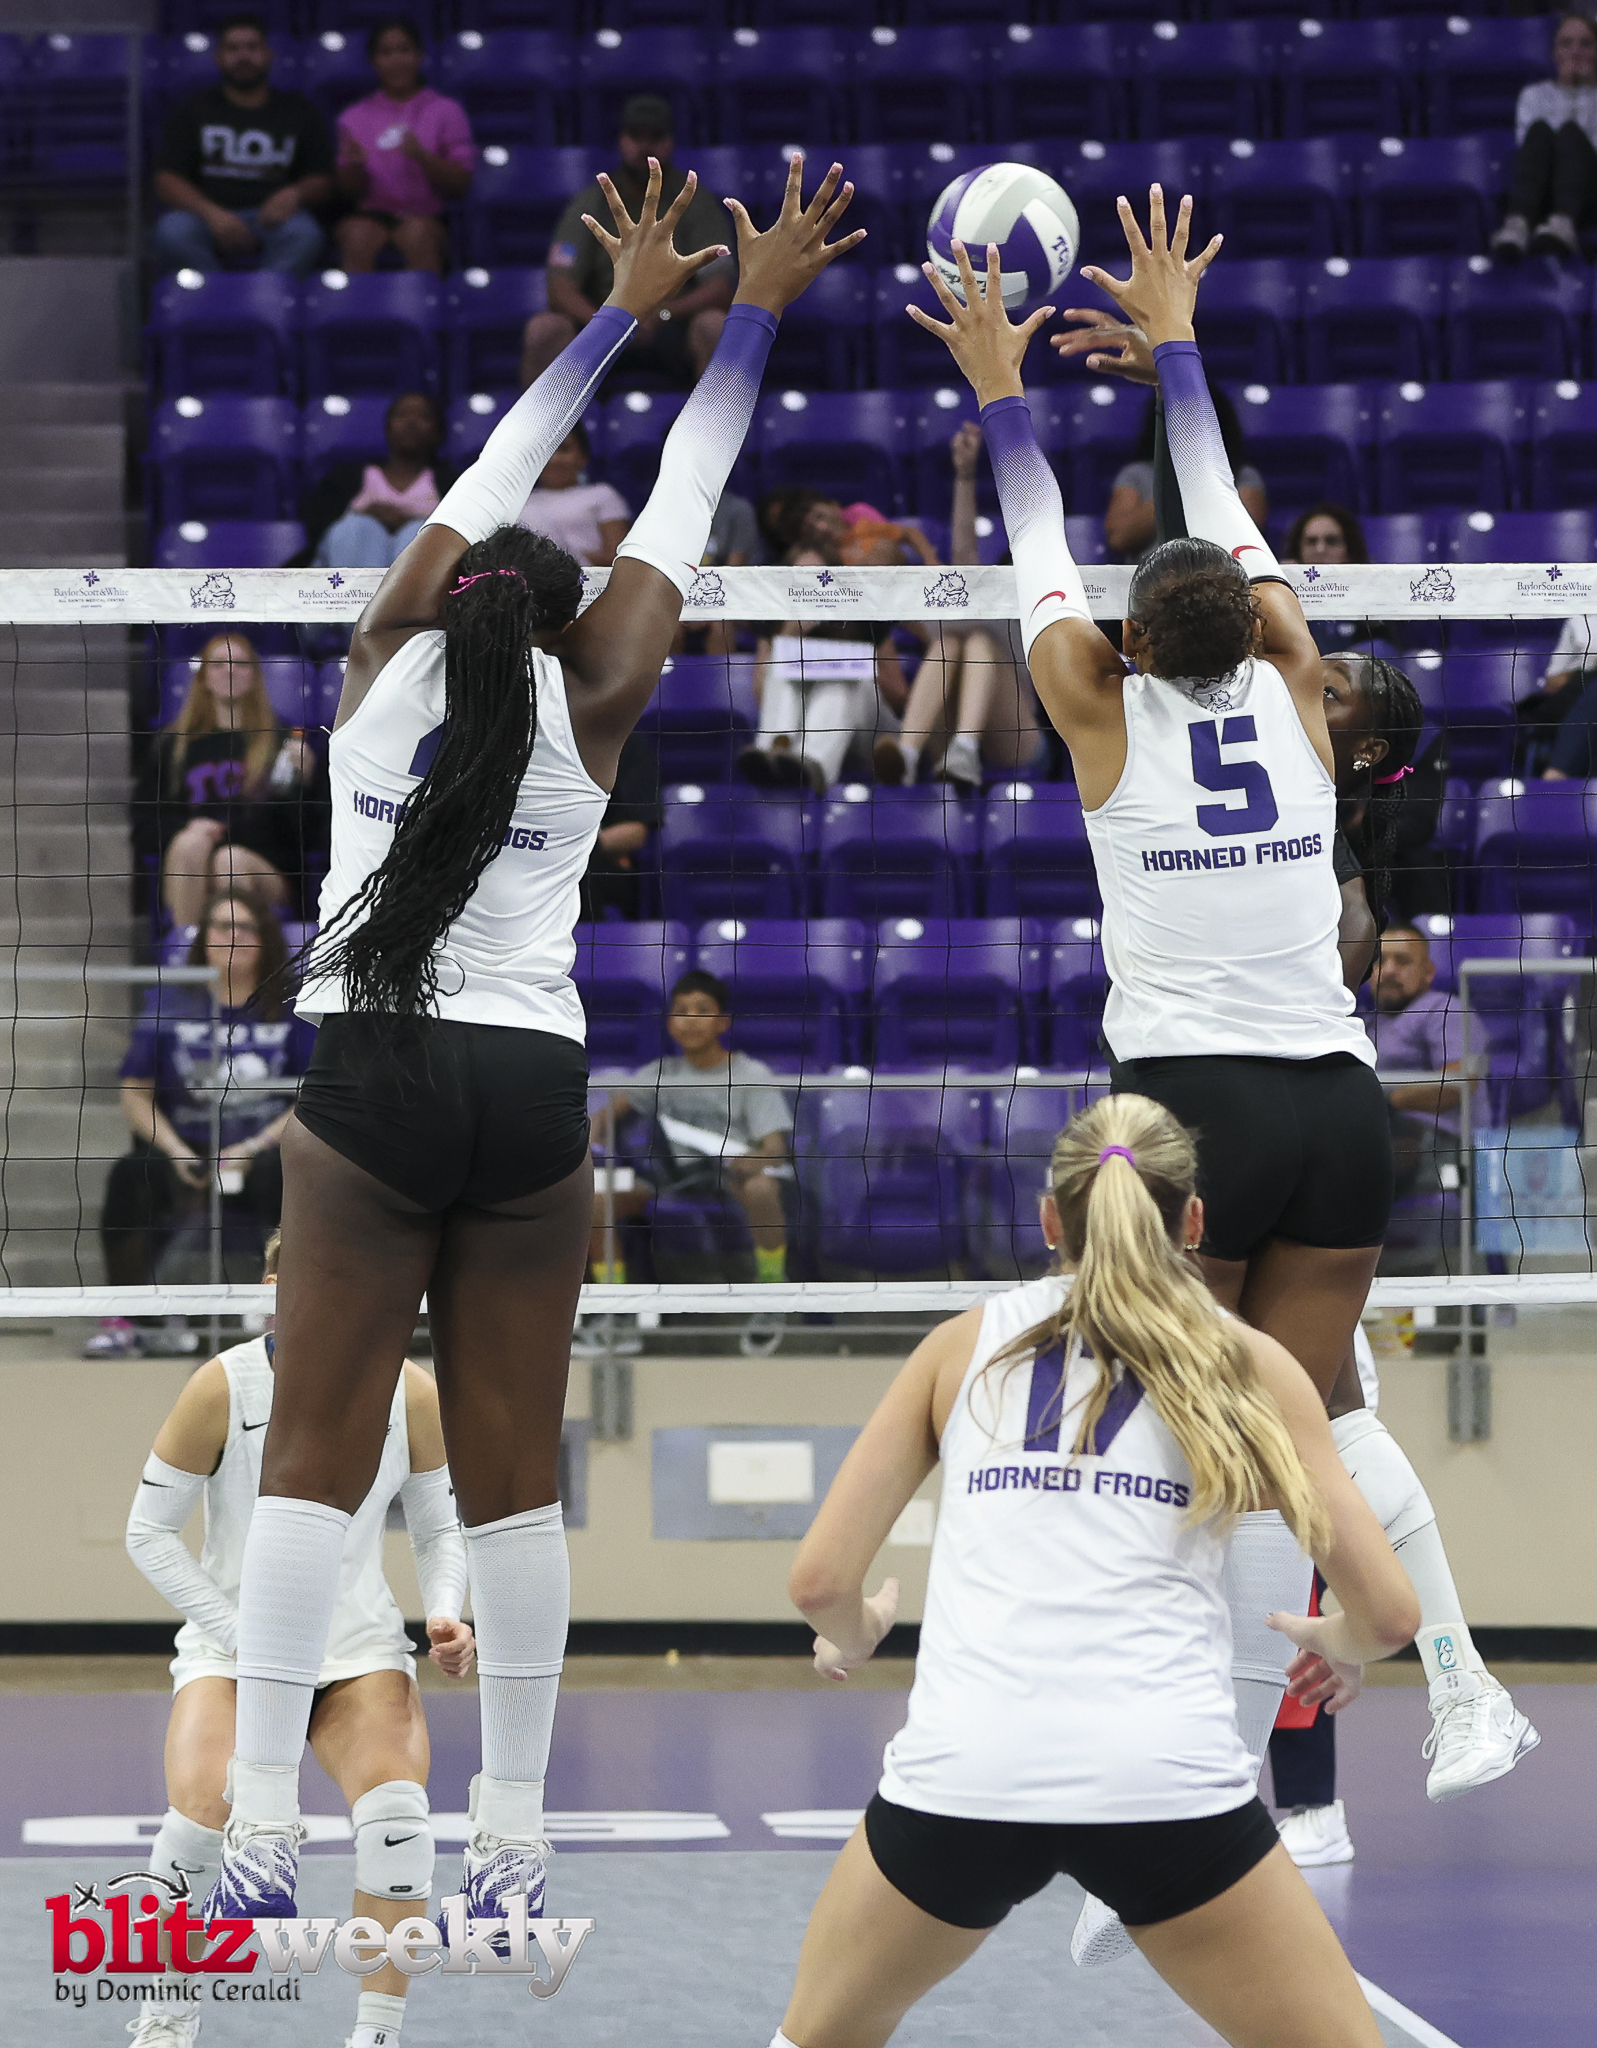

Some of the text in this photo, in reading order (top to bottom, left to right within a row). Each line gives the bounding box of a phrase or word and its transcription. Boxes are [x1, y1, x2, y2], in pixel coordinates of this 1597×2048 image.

[298, 590, 374, 600] BaylorScott&White
[788, 588, 863, 598] BaylorScott&White
[1292, 583, 1349, 592] orScott&White
[1518, 582, 1592, 592] BaylorScott&White
[186, 761, 244, 803] TC
[1188, 715, 1279, 837] 5
[1142, 833, 1322, 871] HORNED FROGS
[968, 1467, 1190, 1507] HORNED FROGS
